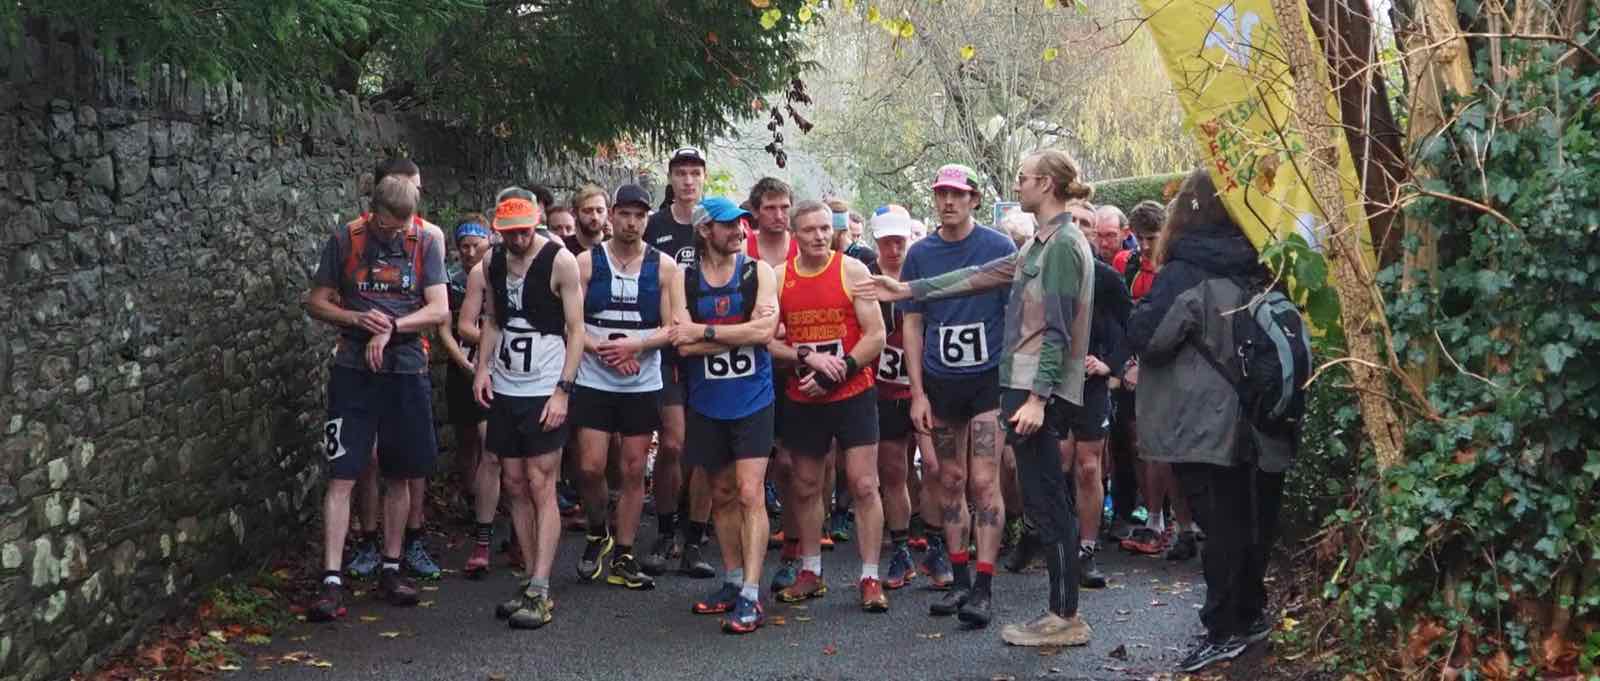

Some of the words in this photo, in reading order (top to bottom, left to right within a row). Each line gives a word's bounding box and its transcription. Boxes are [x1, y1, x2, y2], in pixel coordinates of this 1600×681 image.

[499, 331, 533, 373] 49
[708, 347, 751, 376] 66
[943, 327, 981, 363] 69
